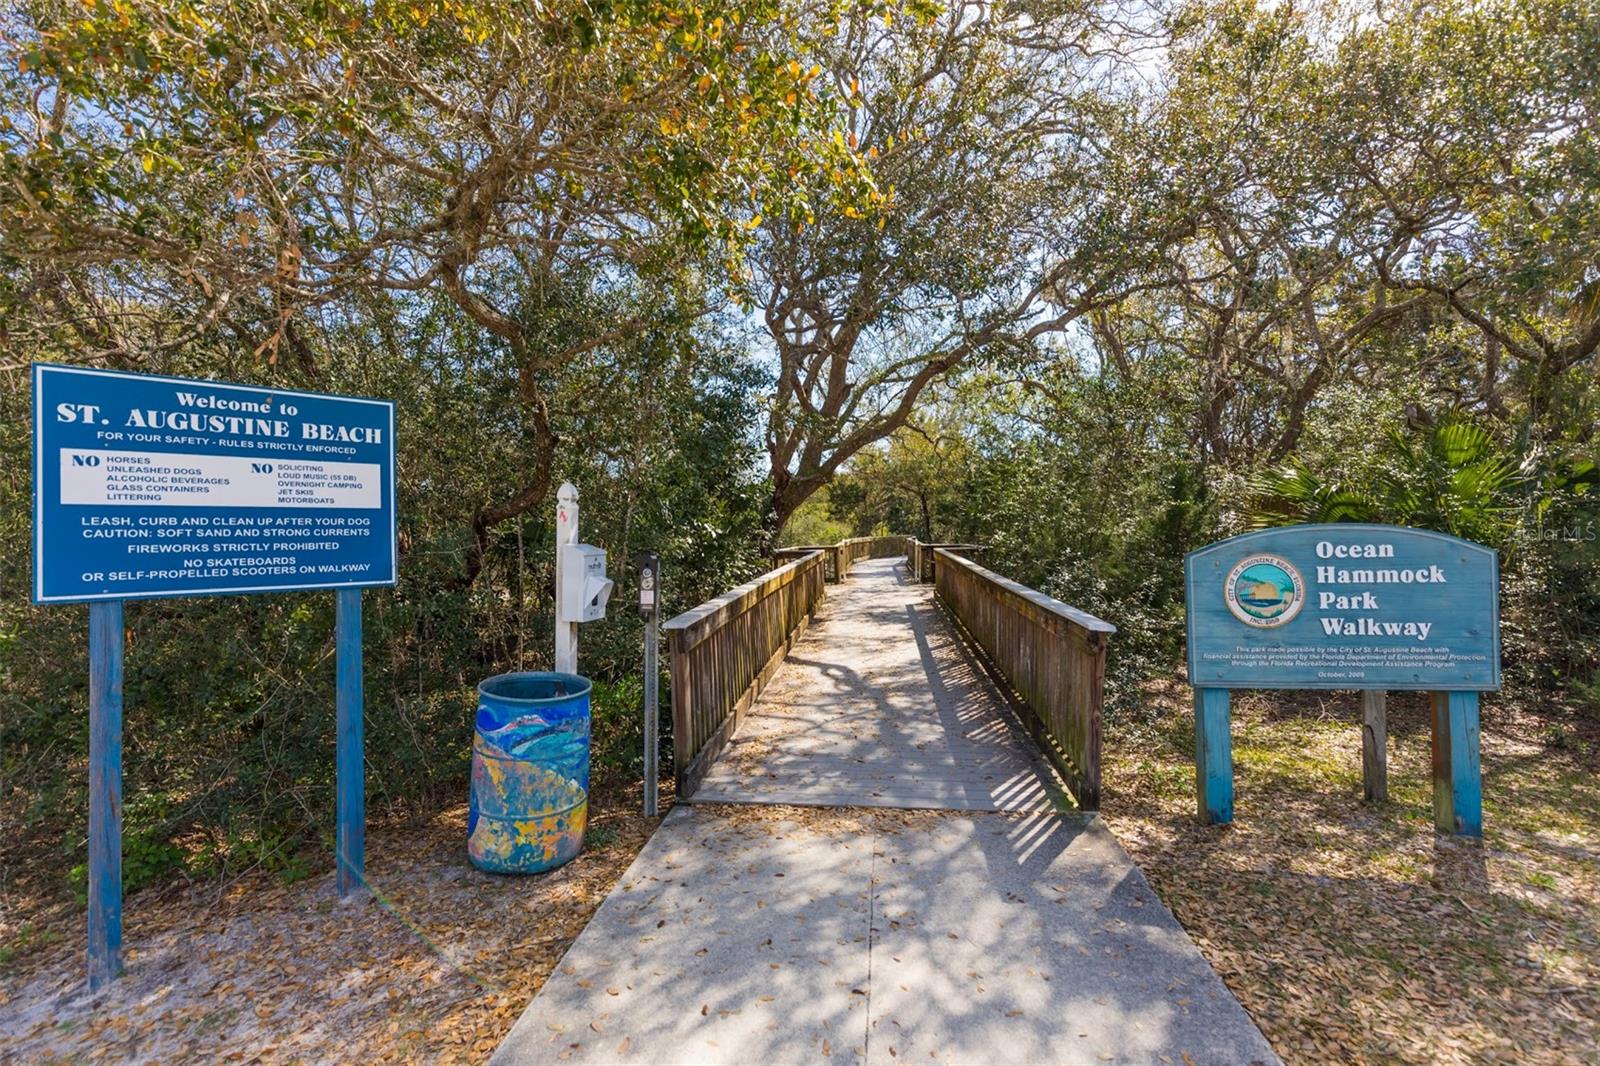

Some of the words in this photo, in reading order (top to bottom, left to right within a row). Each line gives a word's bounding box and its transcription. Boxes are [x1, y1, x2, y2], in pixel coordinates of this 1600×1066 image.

[176, 392, 271, 413] Welcome
[280, 403, 298, 416] to
[56, 402, 110, 425] ST.
[124, 408, 290, 438] AUGUSTINE
[302, 422, 382, 444] BEACH
[97, 431, 124, 440] FOR
[127, 433, 162, 442] YOUR
[165, 435, 210, 445] SAFETY
[218, 439, 254, 448] RULES
[256, 441, 304, 452] STRICTLY
[306, 444, 357, 454] ENFORCED
[72, 455, 100, 467] NO
[106, 456, 150, 464] HORSES
[106, 466, 171, 474] UNLEASHED
[250, 463, 273, 474] NO
[278, 464, 324, 472] SOLICITING
[106, 475, 168, 484] ALCOHOLIC
[171, 477, 230, 486] BEVERAGES
[106, 484, 144, 492] GLASS
[146, 485, 210, 494] CONTAINERS
[82, 516, 134, 526] LEASH,
[138, 516, 178, 526] CURB
[181, 517, 208, 526] AND
[212, 517, 254, 526] CLEAN
[257, 518, 273, 526] UP
[276, 518, 312, 526] AFTER
[82, 529, 153, 538] CAUTION:
[156, 528, 192, 538] SOFT
[196, 528, 232, 537] SAND
[234, 528, 260, 537] AND
[263, 528, 310, 537] STRONG
[313, 528, 370, 536] CURRENTS
[128, 544, 210, 554] FIREWORKS
[212, 543, 270, 552] STRICTLY
[273, 542, 340, 551] PROHIBITED
[1316, 541, 1394, 559] Ocean
[184, 559, 203, 568] NO
[206, 556, 296, 568] SKATEBOARDS
[82, 572, 104, 582] OR
[108, 568, 229, 580] SELF-PROPELLED
[232, 566, 296, 576] SCOOTERS
[300, 565, 316, 574] ON
[318, 563, 370, 573] WALKWAY
[1316, 564, 1447, 584] Hammock
[1318, 592, 1379, 610] Park
[1320, 618, 1432, 640] Walkway
[1287, 646, 1316, 654] possible
[1231, 660, 1258, 668] through
